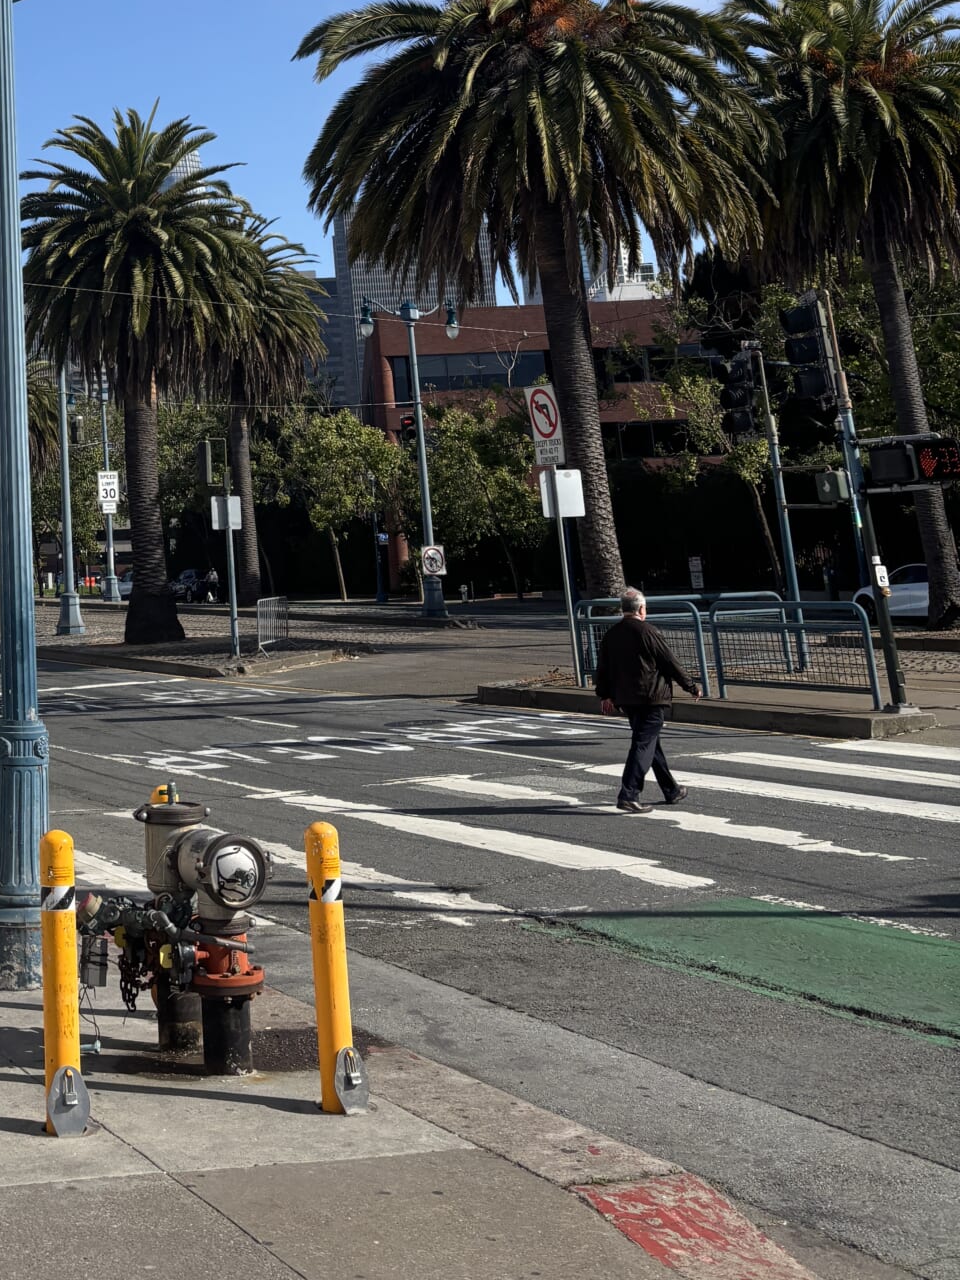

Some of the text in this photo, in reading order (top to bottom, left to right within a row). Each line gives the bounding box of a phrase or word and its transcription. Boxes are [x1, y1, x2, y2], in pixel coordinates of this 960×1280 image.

[536, 438, 561, 448] EXCEPT TRUCKS
[102, 488, 116, 499] 30
